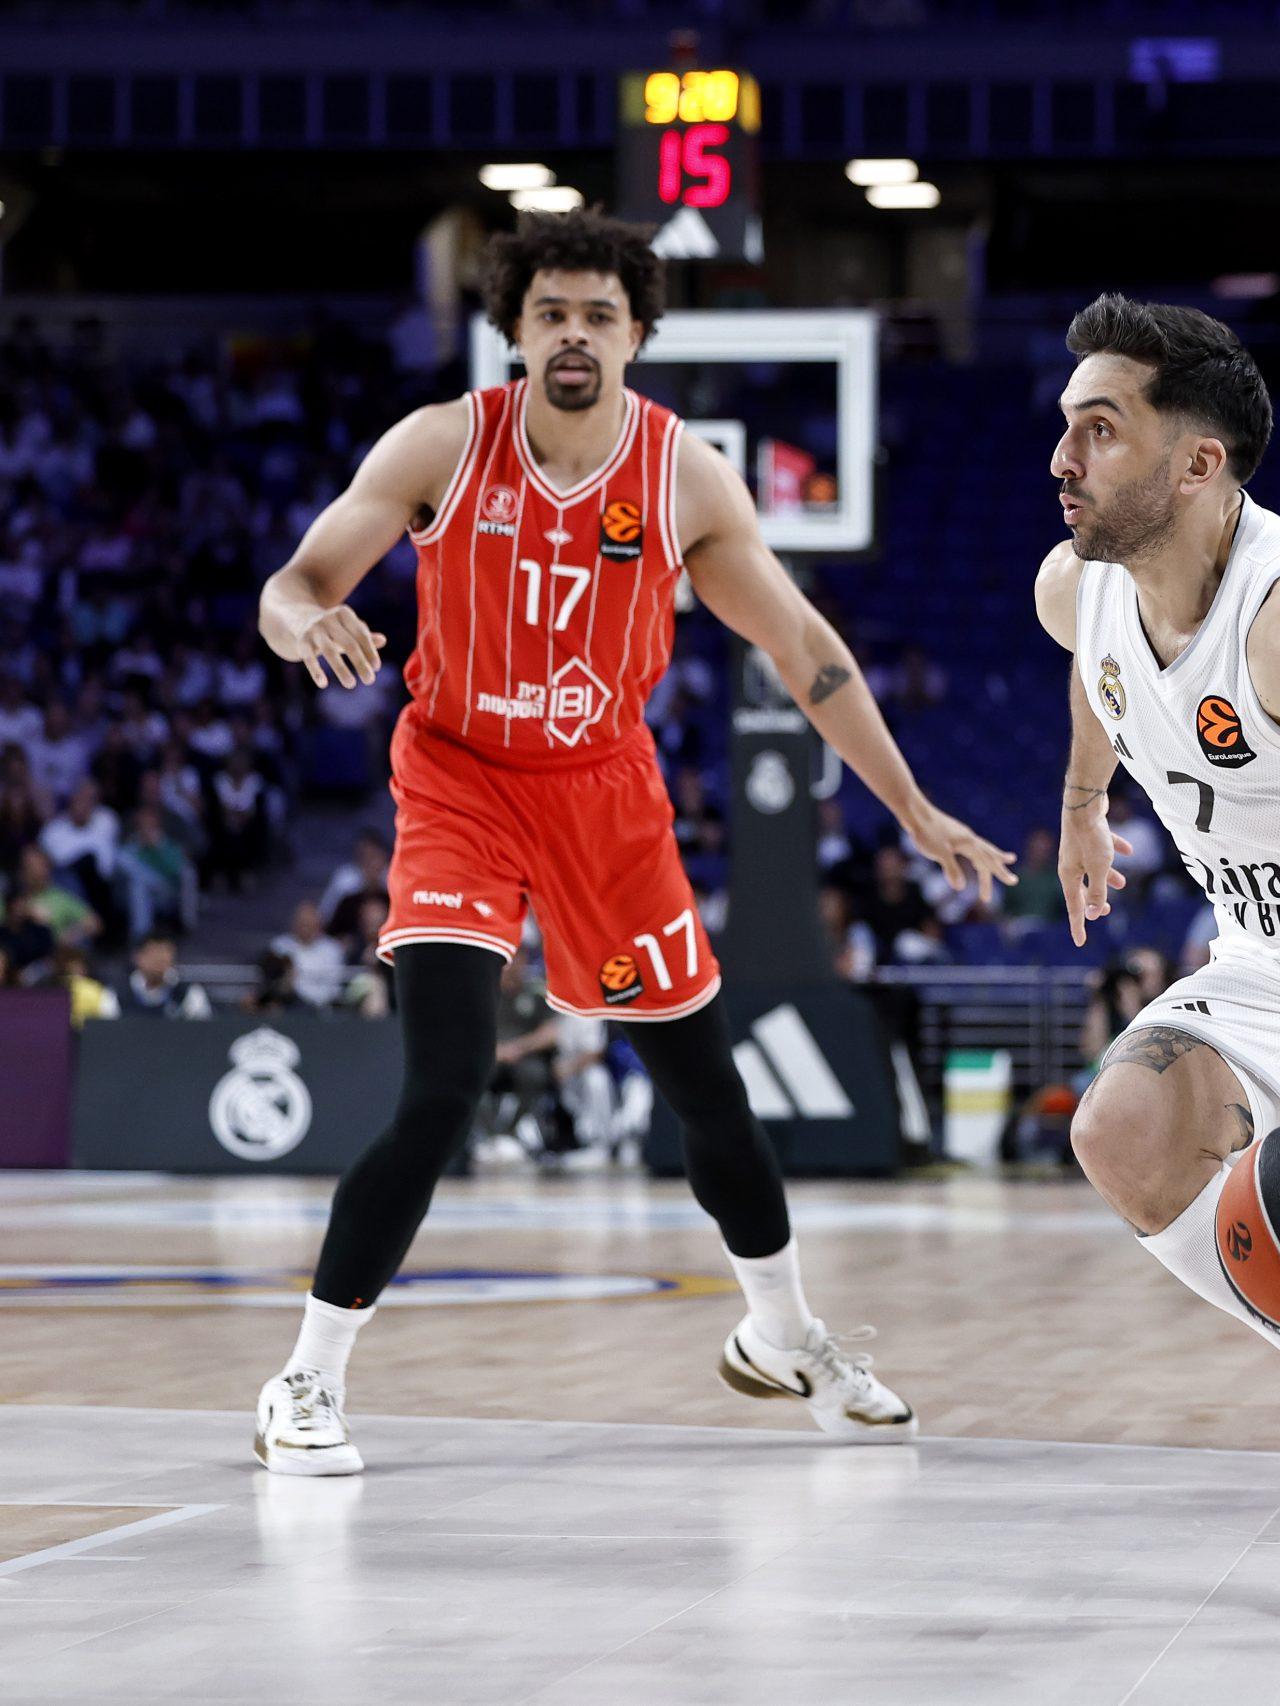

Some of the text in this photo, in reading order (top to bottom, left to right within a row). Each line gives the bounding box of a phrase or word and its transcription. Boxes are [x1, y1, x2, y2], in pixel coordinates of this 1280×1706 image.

[658, 124, 731, 209] 15
[519, 558, 591, 632] 17
[548, 683, 593, 719] IBI
[1207, 752, 1252, 761] EuroLeague
[1166, 770, 1215, 833] 7
[633, 908, 698, 991] 17
